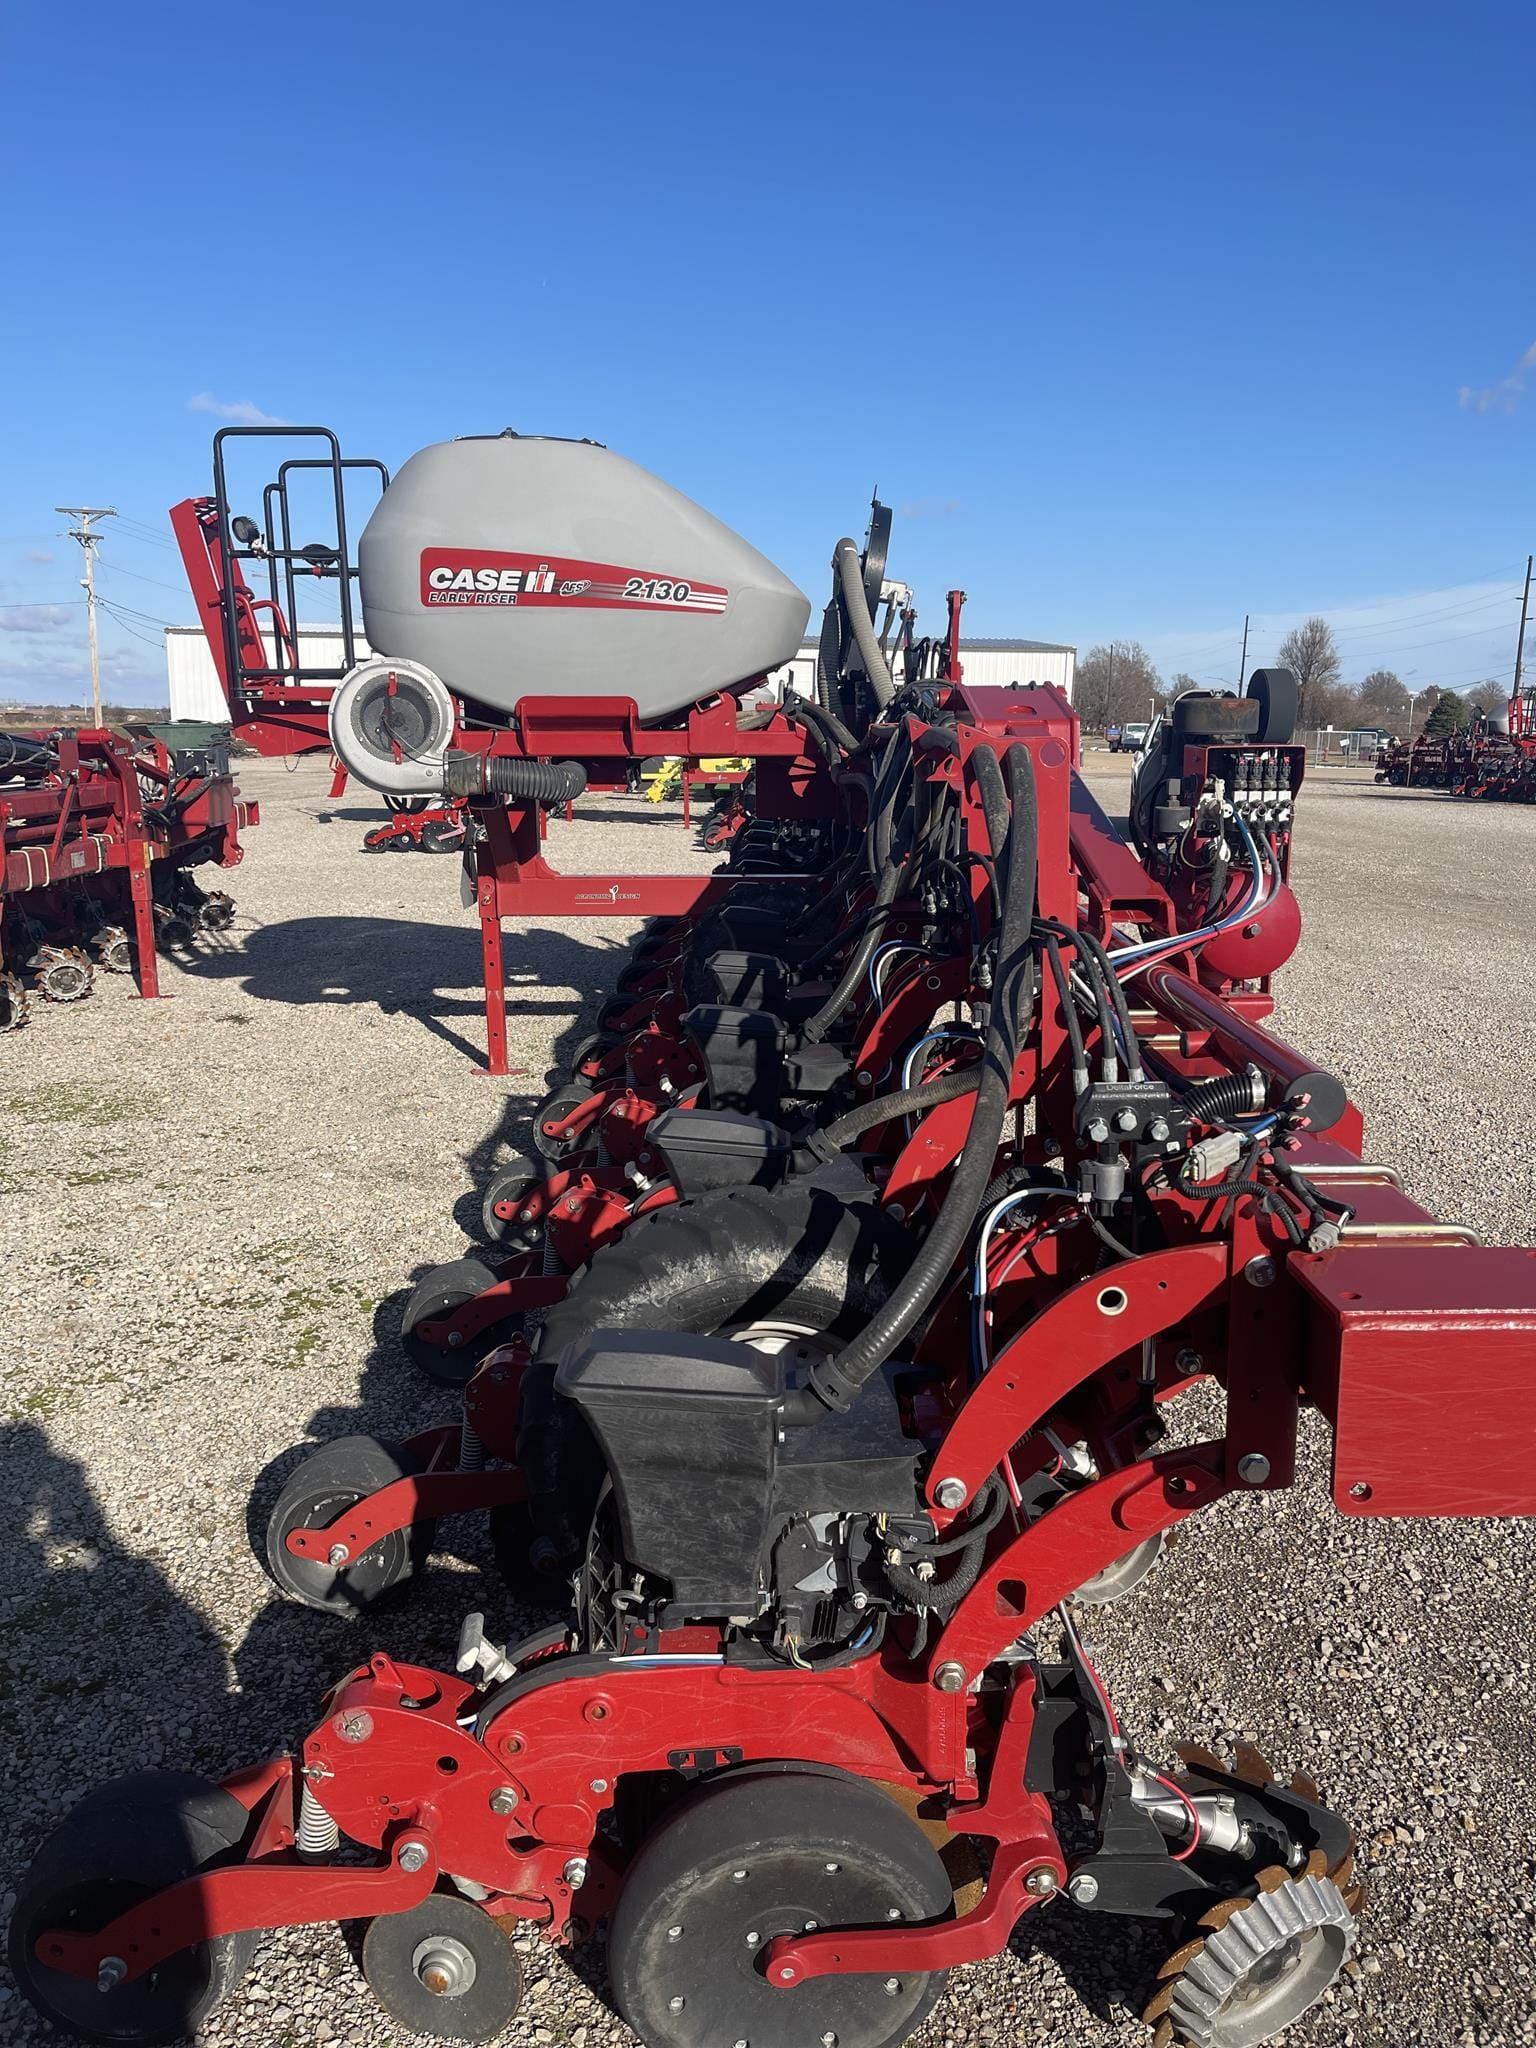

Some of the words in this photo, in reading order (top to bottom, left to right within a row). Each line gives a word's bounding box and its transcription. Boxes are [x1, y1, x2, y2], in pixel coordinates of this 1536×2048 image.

[429, 567, 522, 591] CASE
[623, 578, 690, 602] 2130
[428, 591, 472, 604] EARLY
[475, 592, 517, 605] RISER
